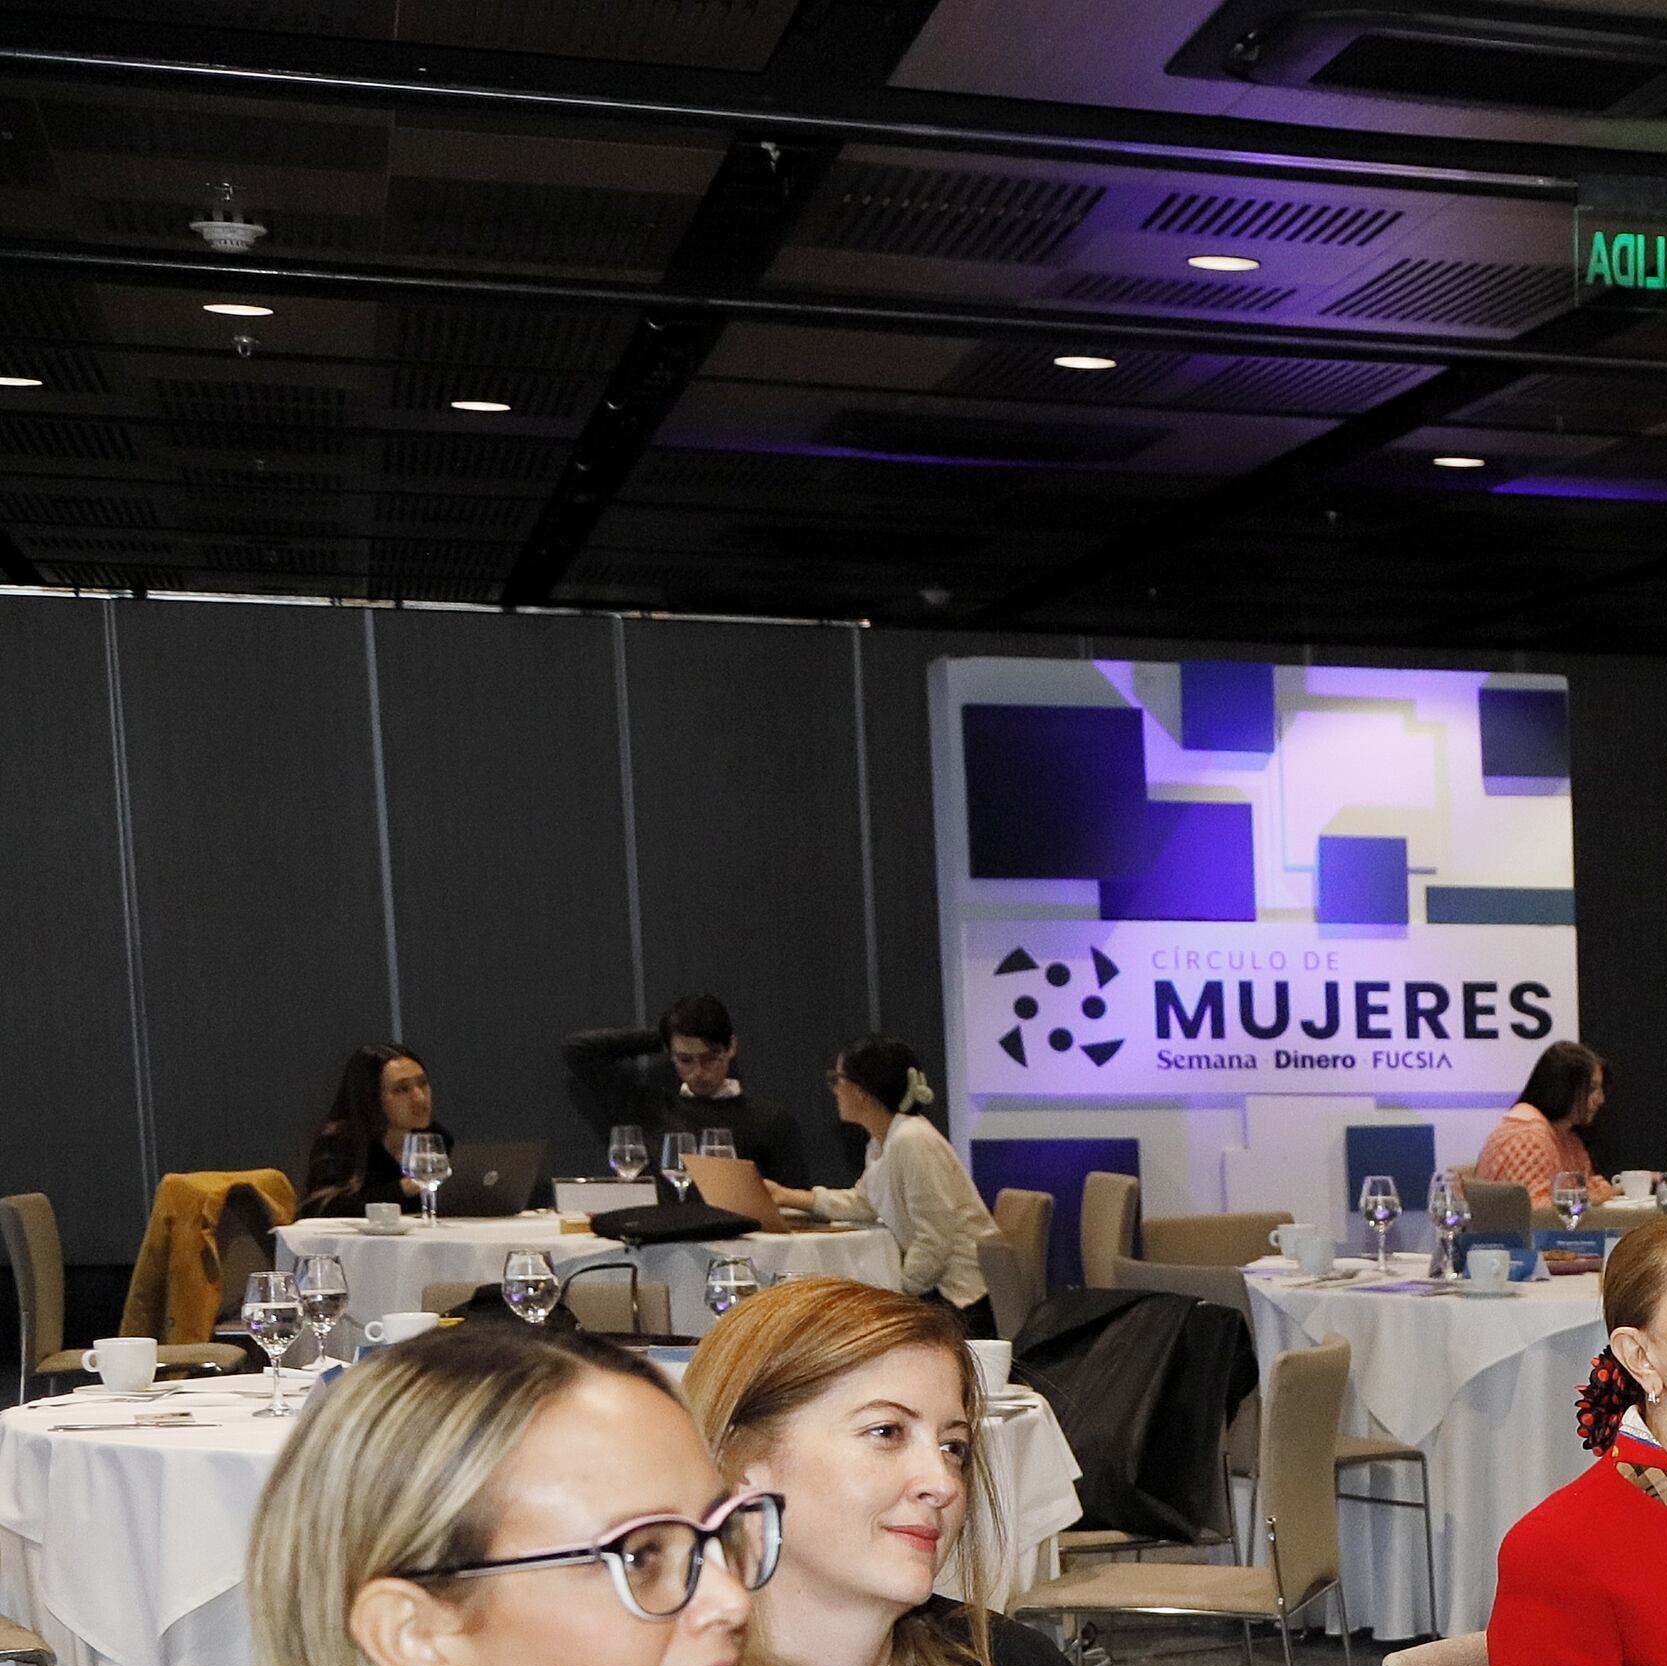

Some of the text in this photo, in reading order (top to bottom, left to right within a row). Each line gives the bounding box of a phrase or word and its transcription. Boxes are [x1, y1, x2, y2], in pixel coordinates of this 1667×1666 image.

[1151, 946, 1340, 972] CÍRCULO DE
[1154, 980, 1553, 1040] MUJERES
[1157, 1048, 1453, 1070] Semana Dinero FUCSIA
